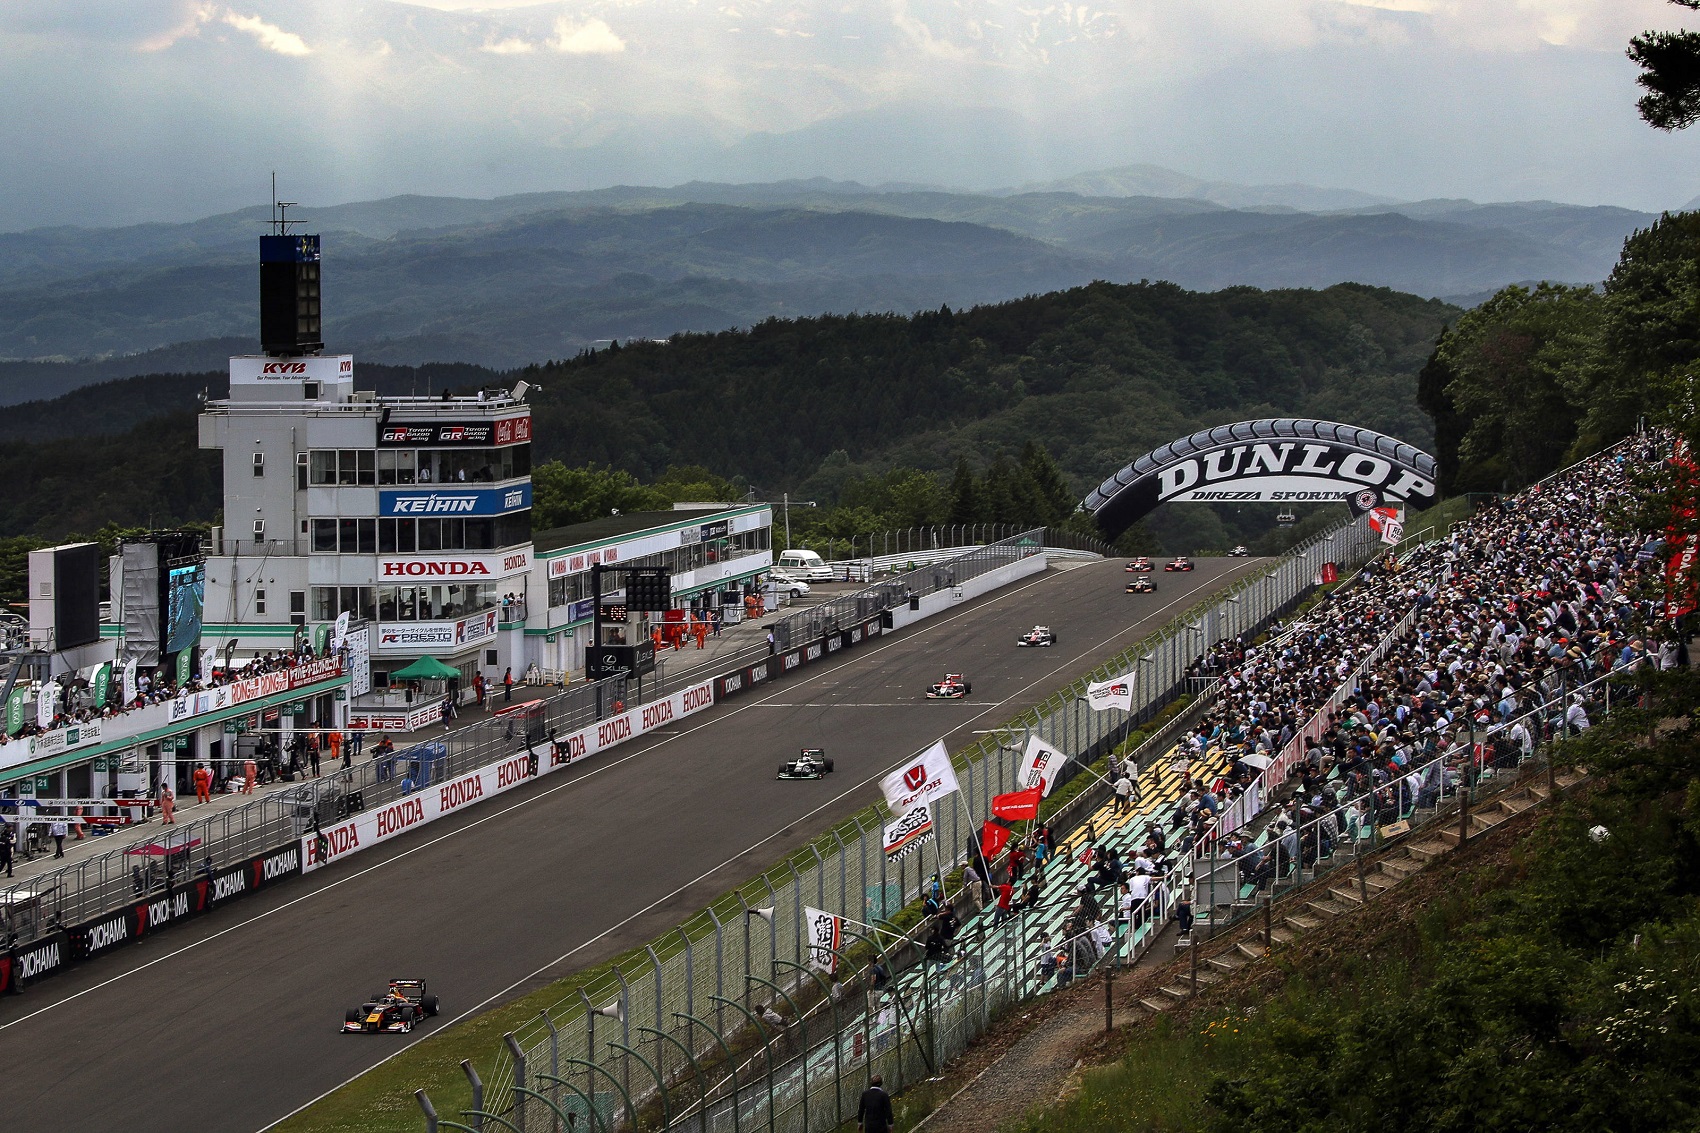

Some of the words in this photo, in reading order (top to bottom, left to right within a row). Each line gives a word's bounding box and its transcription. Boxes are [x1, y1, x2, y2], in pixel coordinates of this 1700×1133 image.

[263, 363, 307, 374] KYB
[340, 361, 351, 372] KYB
[383, 432, 405, 441] GR
[439, 431, 462, 440] GR
[1158, 443, 1435, 501] DUNLOP
[393, 499, 476, 512] KEIHIN
[505, 494, 522, 508] KEIHIN
[1191, 491, 1262, 501] DIREZZA
[1271, 491, 1348, 501] SPORTM
[383, 562, 490, 576] HONDA
[504, 554, 526, 571] HONDA
[467, 622, 485, 634] PRESTO
[683, 685, 711, 713] HONDA
[642, 700, 673, 730] HONDA
[598, 716, 632, 747] HONDA
[550, 734, 586, 767] HDA
[37, 779, 47, 787] 21
[498, 756, 530, 789] HOND
[440, 775, 483, 812] HONDA
[377, 798, 424, 838] HONDA
[307, 823, 359, 866] HNDA
[263, 849, 298, 881] YOKOHAMA
[213, 869, 245, 901] OKOHAMA
[88, 916, 127, 952] OKOHAMA
